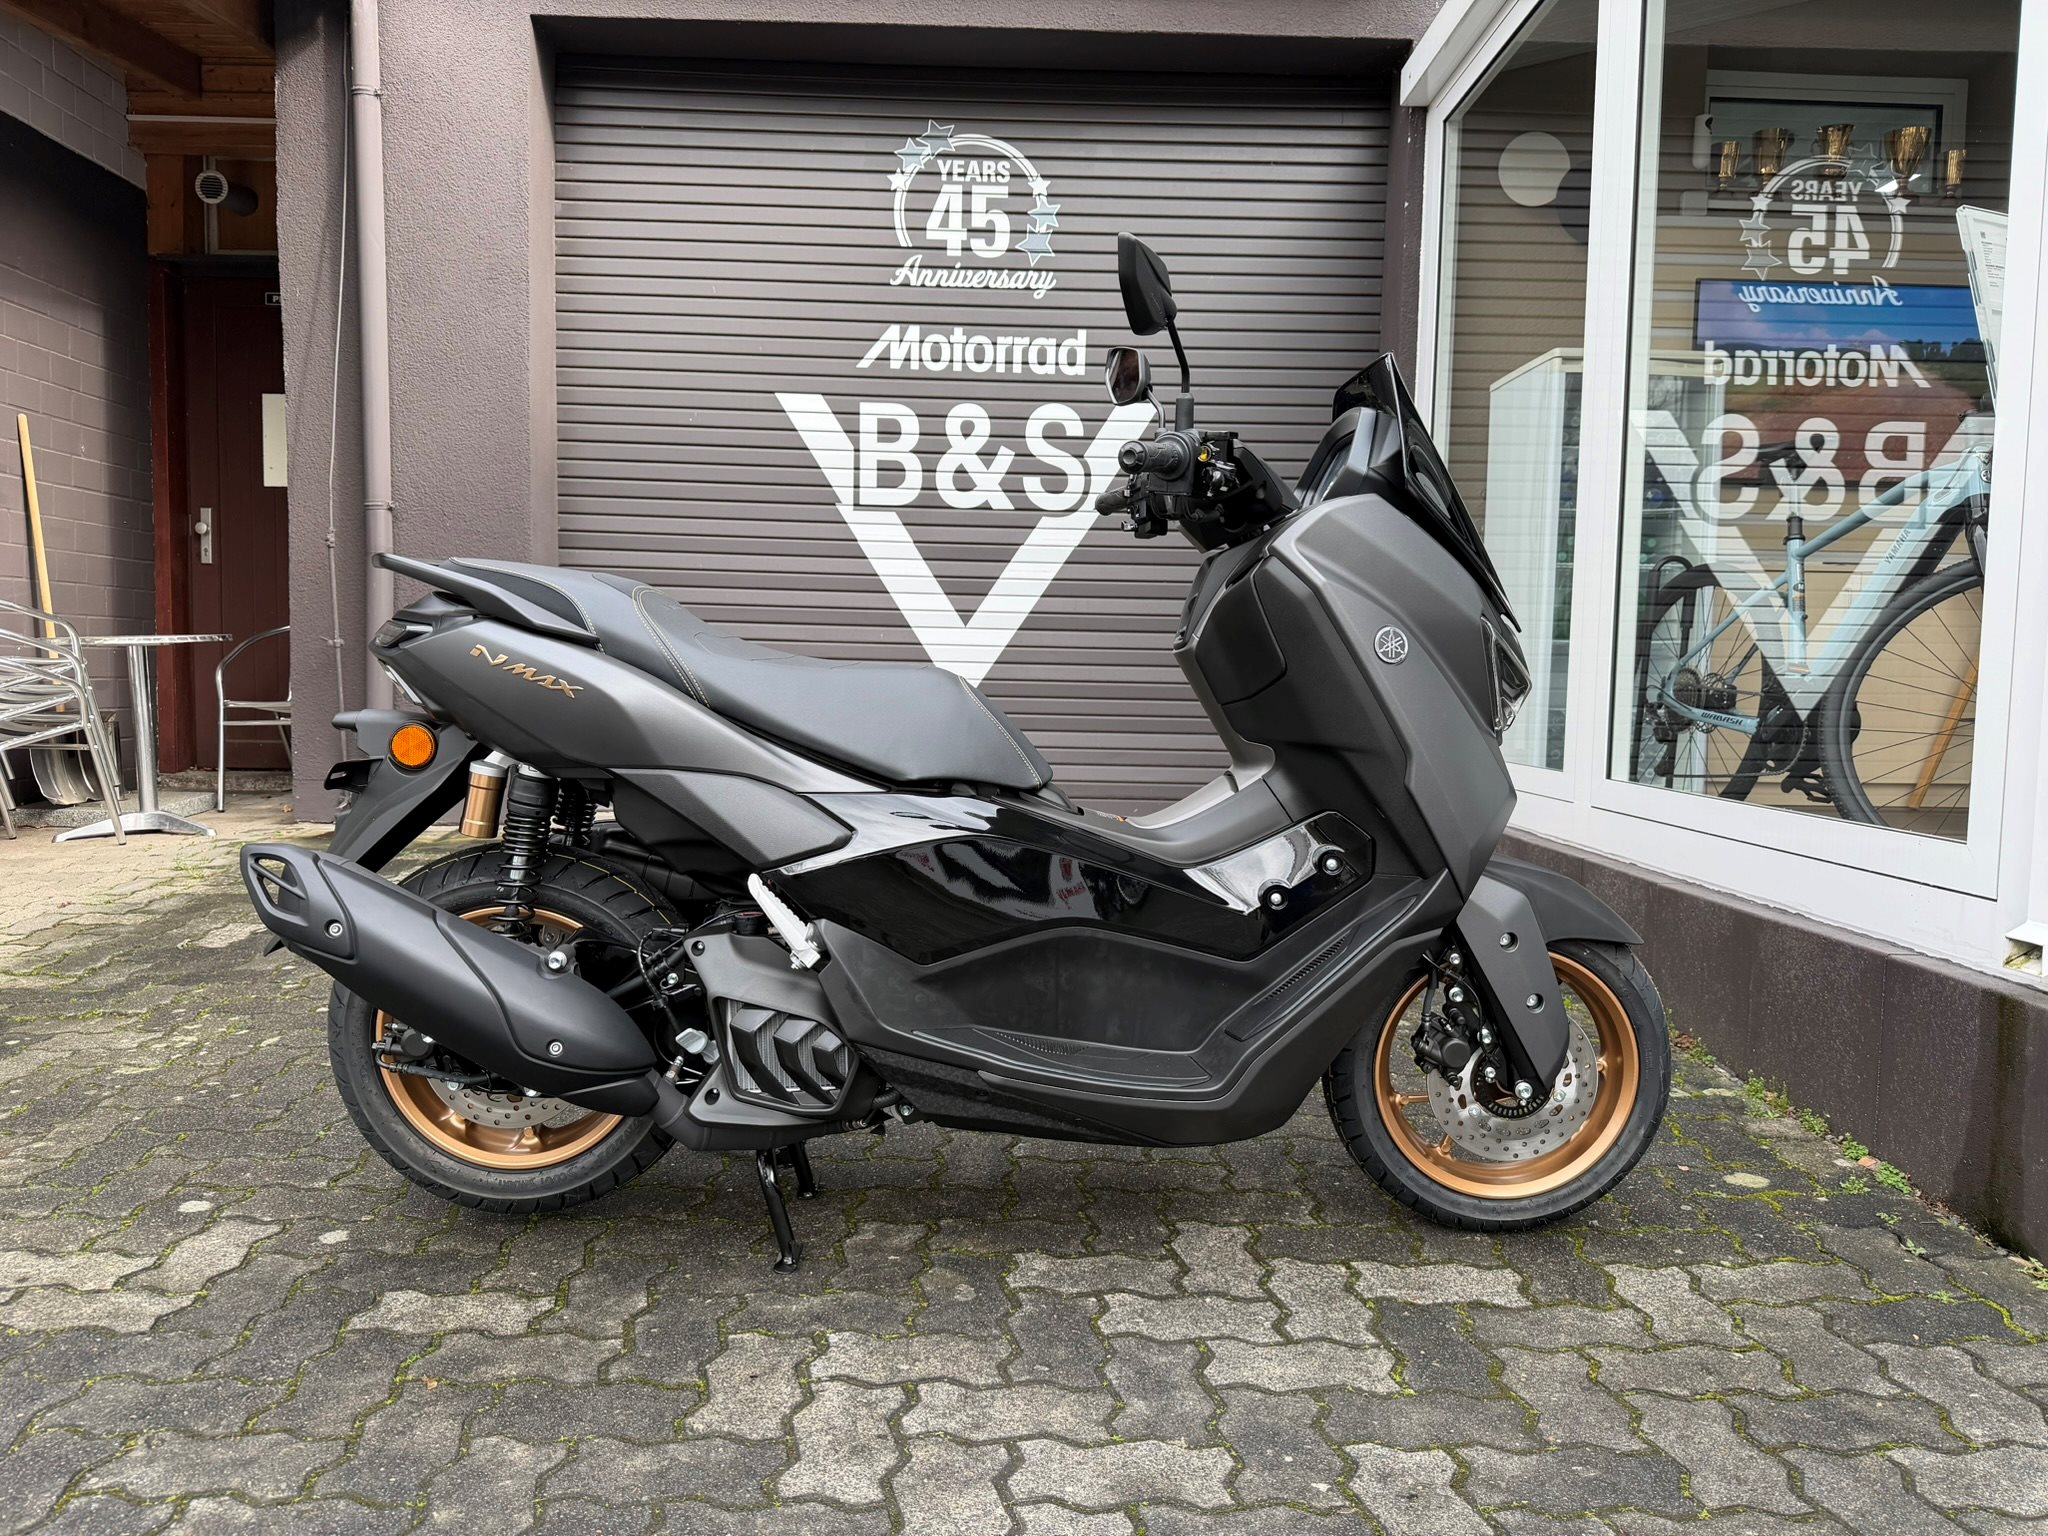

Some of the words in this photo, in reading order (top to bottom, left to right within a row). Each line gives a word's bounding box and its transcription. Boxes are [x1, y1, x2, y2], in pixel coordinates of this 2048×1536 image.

[937, 160, 1011, 183] YEARS
[925, 184, 1011, 258] 45
[889, 254, 1057, 299] Anniversary
[855, 324, 1088, 376] Motorrad
[859, 401, 1086, 511] B&S
[1884, 528, 1911, 565] YAMAHA
[469, 643, 584, 699] NMAX
